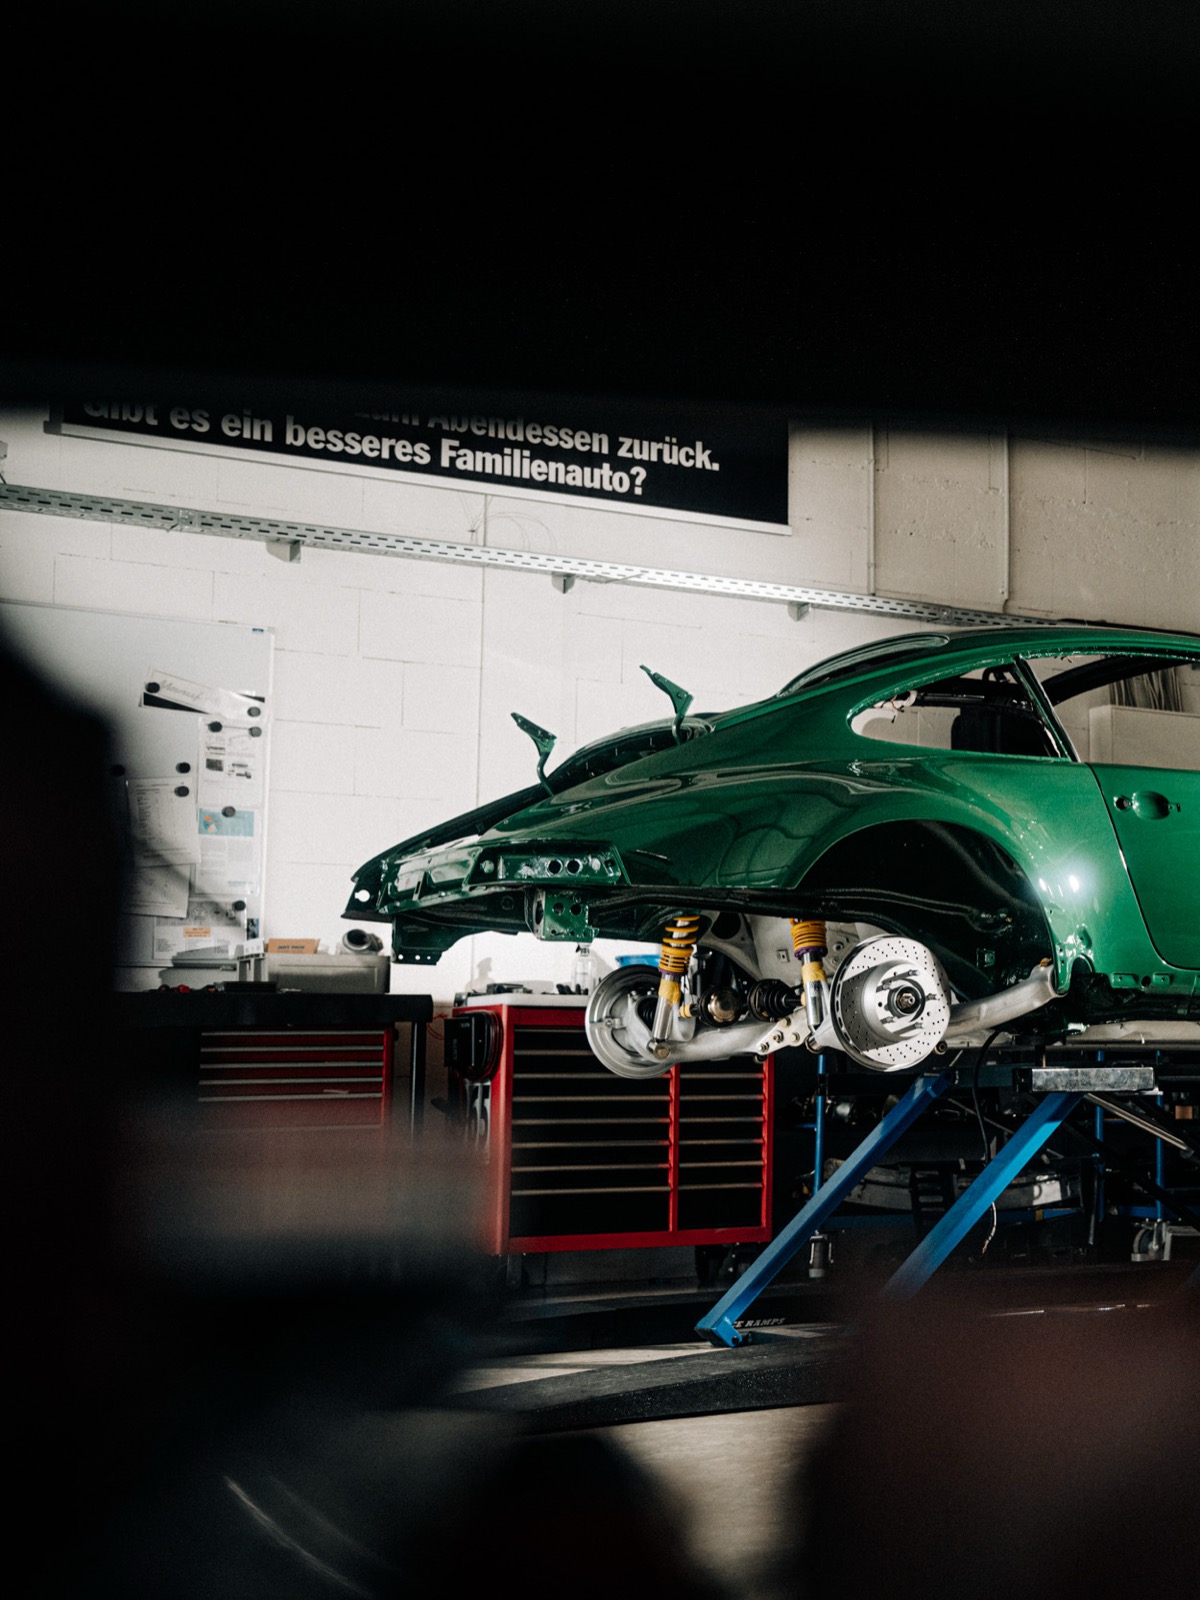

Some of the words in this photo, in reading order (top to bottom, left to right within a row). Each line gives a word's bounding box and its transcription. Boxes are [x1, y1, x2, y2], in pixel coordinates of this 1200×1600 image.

[169, 406, 211, 433] es
[221, 409, 273, 443] ein
[285, 415, 431, 465] besseres
[440, 438, 647, 495] Familienauto?
[616, 436, 720, 472] zurück.
